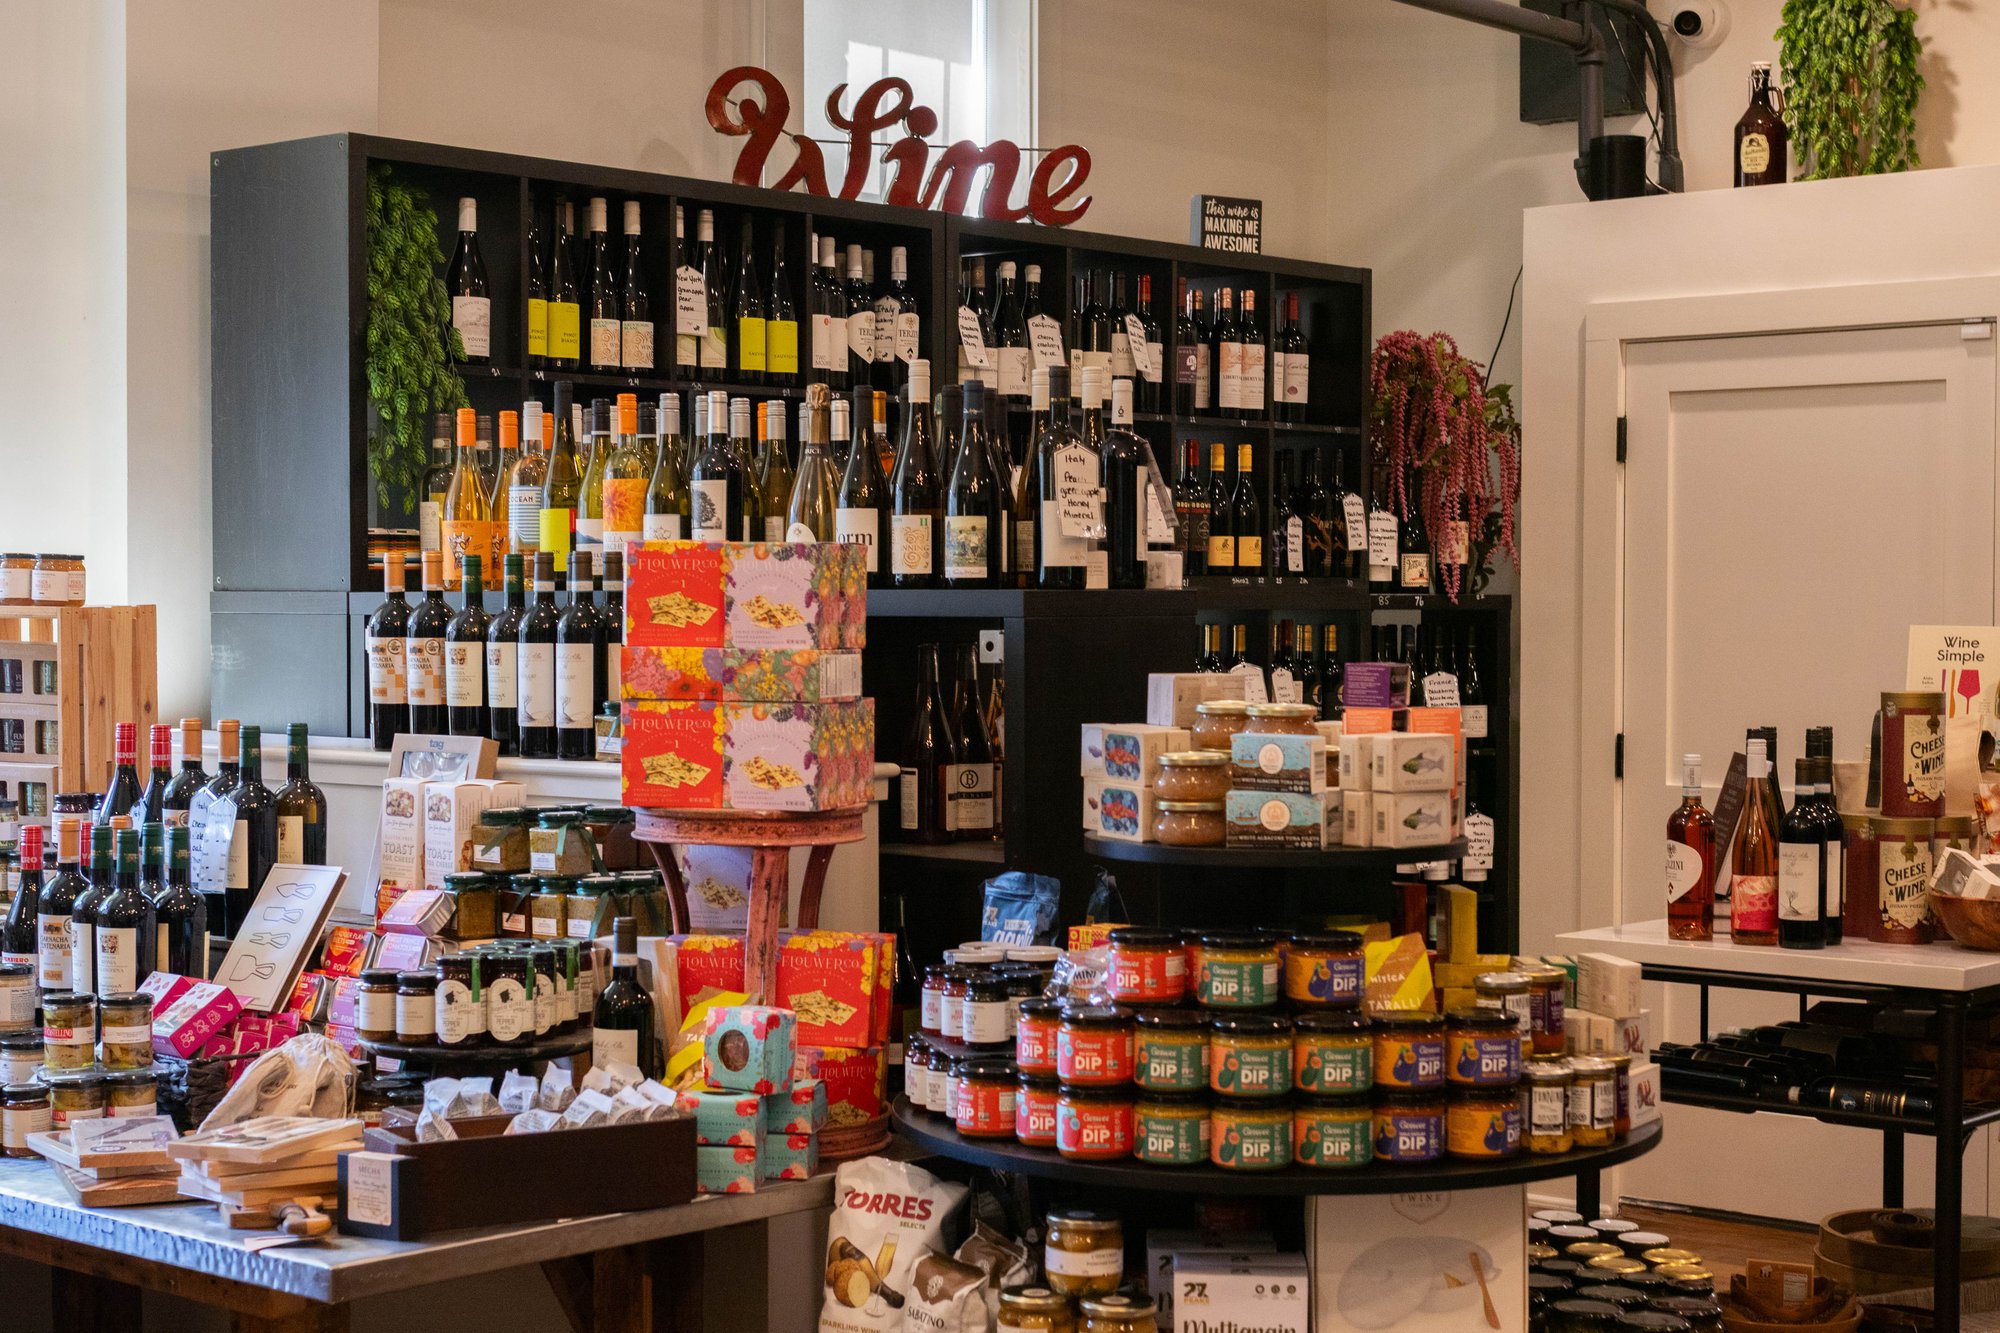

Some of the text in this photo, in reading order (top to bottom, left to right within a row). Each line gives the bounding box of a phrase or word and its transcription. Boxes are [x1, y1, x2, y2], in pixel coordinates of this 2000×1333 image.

[705, 66, 1093, 227] Wine
[1205, 198, 1259, 219] this wine is
[1204, 216, 1259, 235] MAKING ME
[1204, 234, 1259, 254] AWESOME
[1064, 454, 1086, 465] Italy
[1067, 500, 1091, 510] Honey
[1063, 510, 1095, 521] Mineral
[1378, 595, 1390, 606] 85
[1944, 636, 1980, 649] Wine
[1937, 650, 1985, 666] Simple
[429, 738, 444, 751] tag
[384, 842, 415, 856] TOAST
[427, 848, 453, 861] TOAST
[394, 856, 415, 864] CHEESE
[1885, 862, 1927, 887] CHEESE
[1894, 880, 1926, 902] WINE
[333, 962, 346, 972] ROW
[1073, 969, 1097, 980] MINI
[1116, 974, 1140, 988] DIP
[1212, 982, 1239, 996] DIP
[1333, 977, 1357, 992] DIP
[1368, 997, 1421, 1011] TARALLI
[1022, 1044, 1043, 1058] DIP
[1075, 1056, 1102, 1070] DIP
[1418, 1061, 1441, 1076] DIP
[1481, 1058, 1508, 1073] DIP
[1150, 1063, 1177, 1078] DIP
[1241, 1070, 1269, 1084] DIP
[1324, 1068, 1352, 1082] DIP
[957, 1106, 974, 1121] DIP
[1029, 1116, 1055, 1130] DIP
[1083, 1129, 1111, 1144] DIP
[1399, 1136, 1426, 1150] DIP
[1148, 1137, 1174, 1152] DIP
[1242, 1142, 1270, 1157] DIP
[1323, 1141, 1351, 1156] DIP
[900, 1221, 926, 1231] SELECTA
[907, 1306, 945, 1329] SABATINO
[1183, 1319, 1296, 1333] Multigrain
